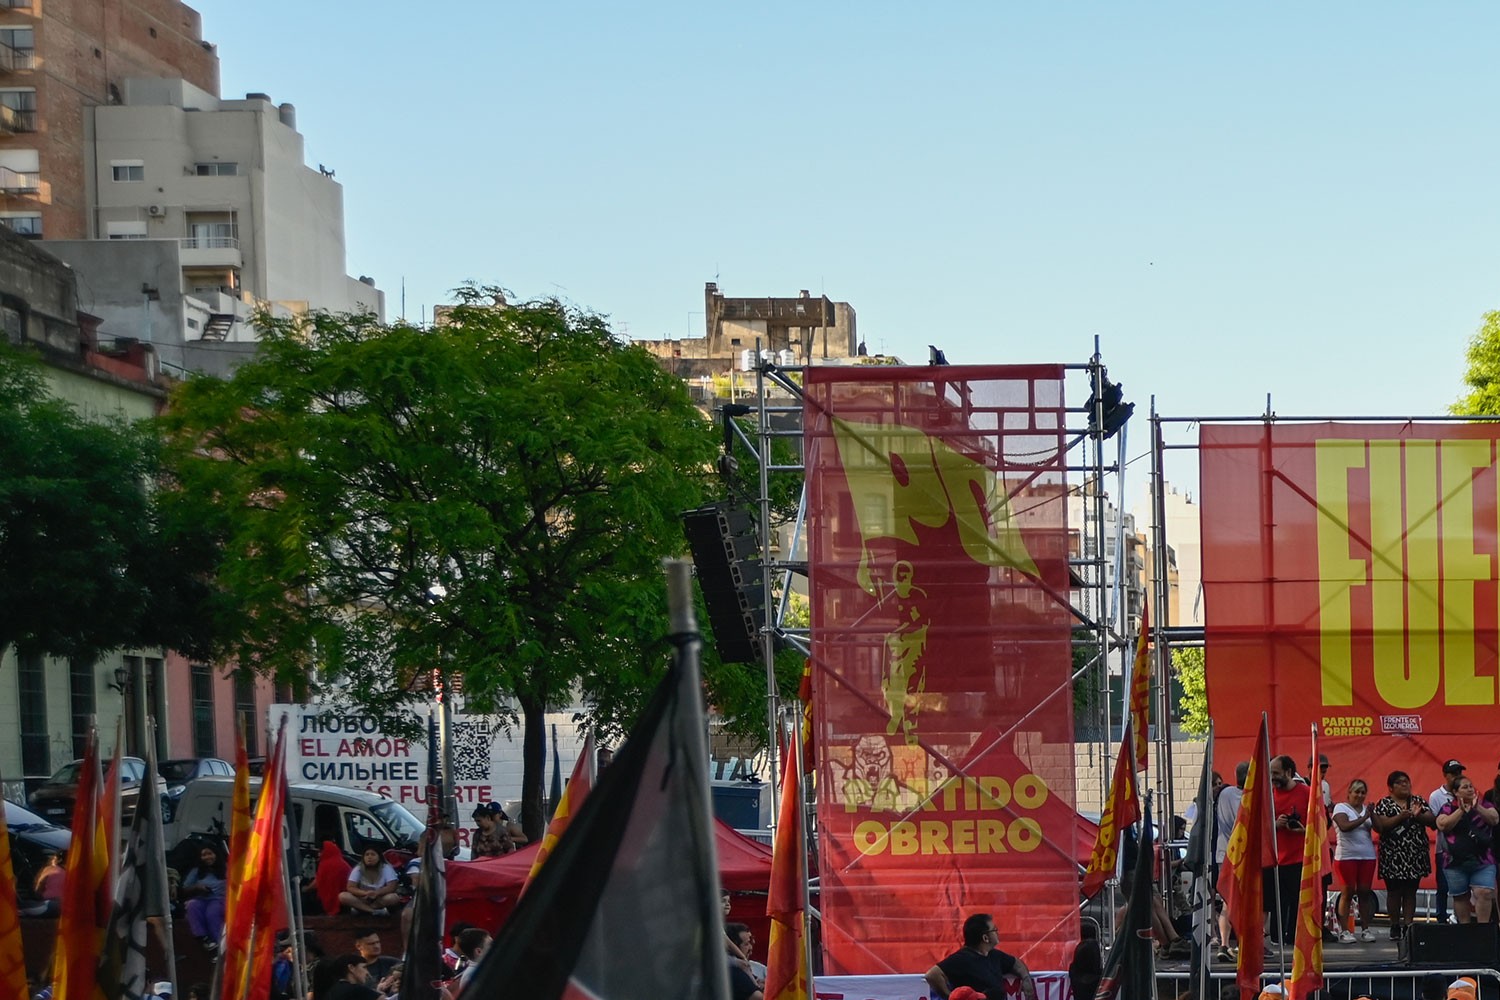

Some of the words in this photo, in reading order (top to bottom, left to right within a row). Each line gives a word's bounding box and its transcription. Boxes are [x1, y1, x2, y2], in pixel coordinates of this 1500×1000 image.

[300, 715, 402, 734] ЛЮБО
[1322, 716, 1373, 727] PARTIDO
[1324, 727, 1371, 736] OBRERO
[300, 739, 330, 757] EL
[336, 738, 410, 757] AMOR
[302, 762, 419, 780] СИЛЬНЕЕ
[400, 785, 492, 804] FURTE
[751, 798, 759, 808] 3
[843, 773, 1049, 814] PARTIDO
[853, 817, 1042, 856] OBRERO
